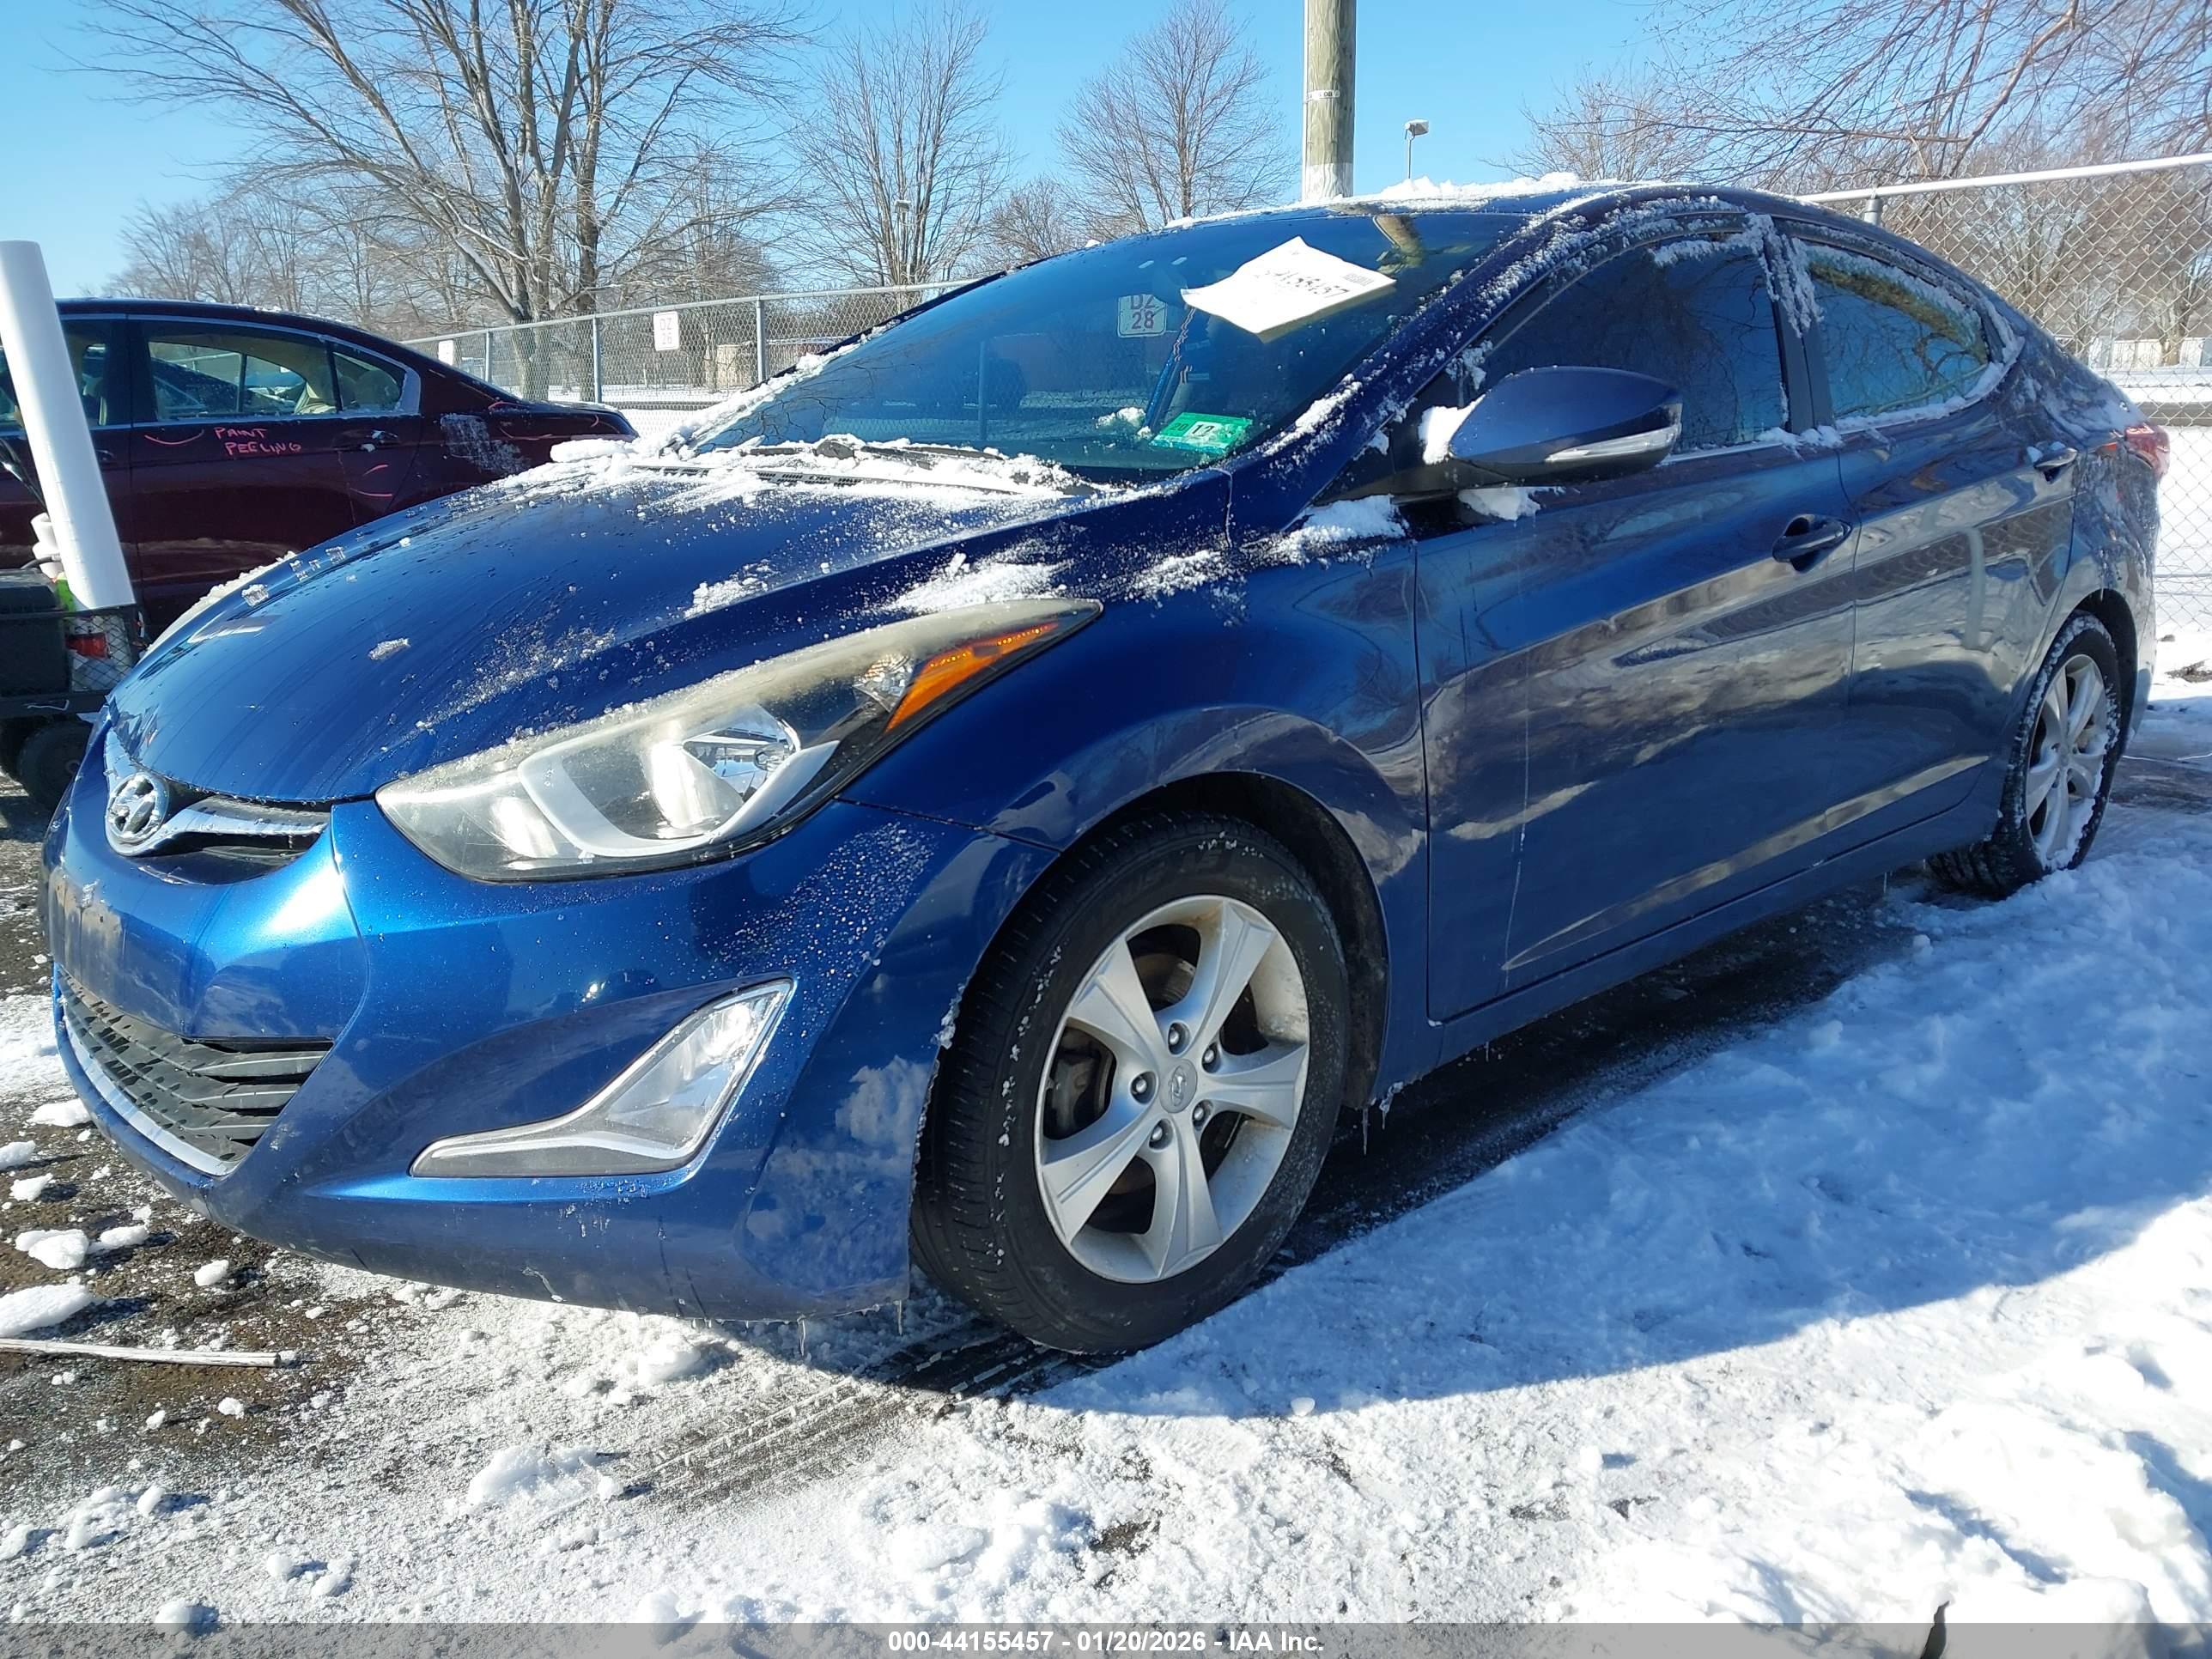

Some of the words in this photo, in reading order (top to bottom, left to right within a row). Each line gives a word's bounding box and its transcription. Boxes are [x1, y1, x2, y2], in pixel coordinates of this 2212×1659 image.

[1130, 294, 1156, 310] DZ
[1131, 310, 1155, 330] 28
[214, 427, 269, 440] PAINT
[1170, 422, 1189, 432] 20
[225, 441, 301, 455] PEELING
